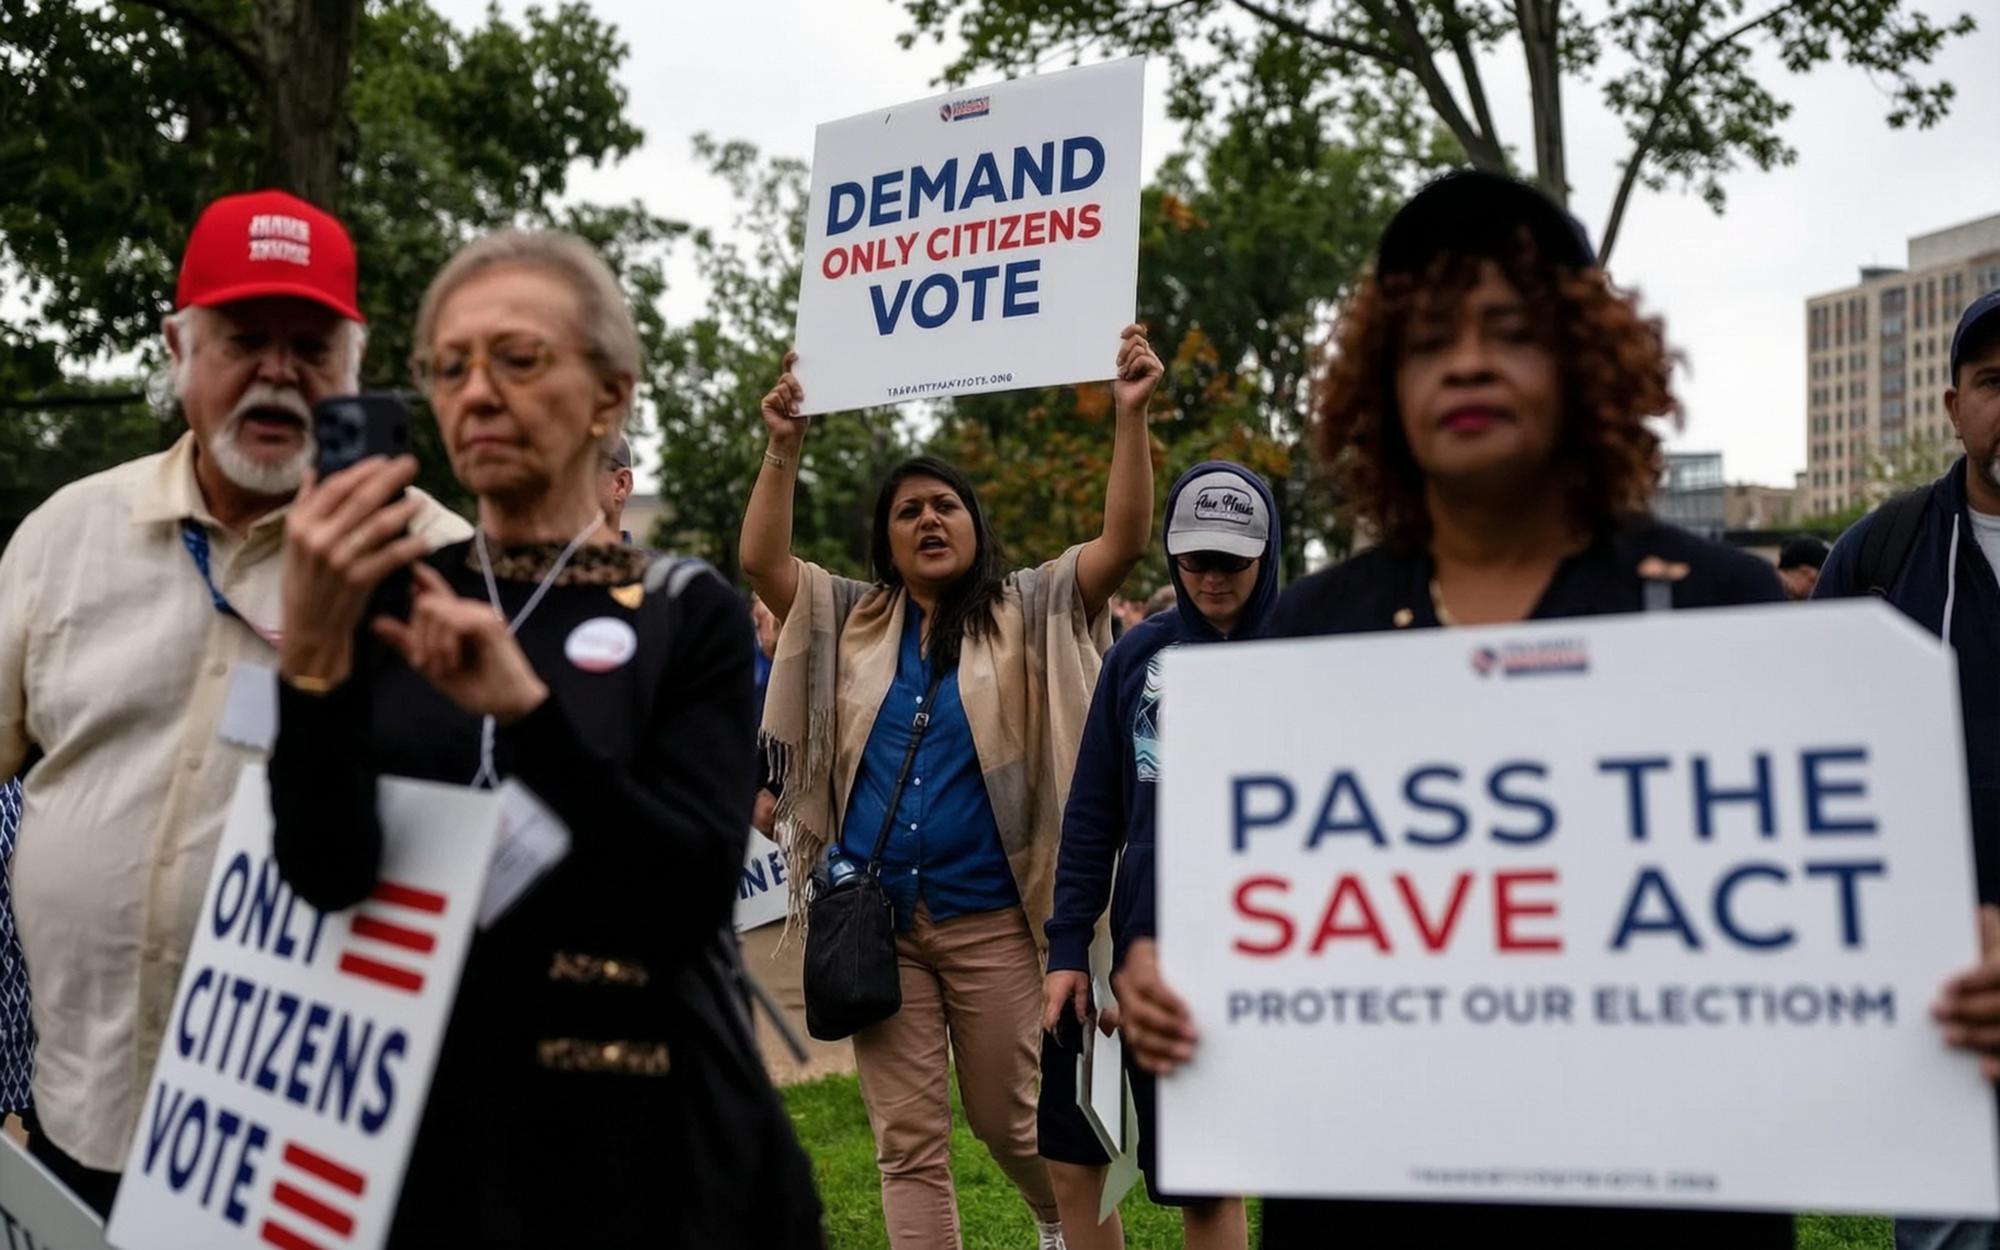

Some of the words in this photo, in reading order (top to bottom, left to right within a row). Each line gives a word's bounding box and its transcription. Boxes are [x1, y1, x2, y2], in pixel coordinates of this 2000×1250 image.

[825, 136, 1106, 237] DEMAND
[821, 231, 919, 280] ONLY
[926, 203, 1102, 262] CITIZENS
[868, 258, 1041, 337] VOTE
[1229, 759, 1559, 854] PASS
[1595, 745, 1881, 843] THE
[1230, 868, 1564, 958] SAVE
[1607, 857, 1888, 954] ACT
[177, 966, 409, 1136] CITIZENS
[1227, 986, 1446, 1025] PROTECT
[1462, 985, 1575, 1025] OUR
[143, 1081, 270, 1228] VOTE
